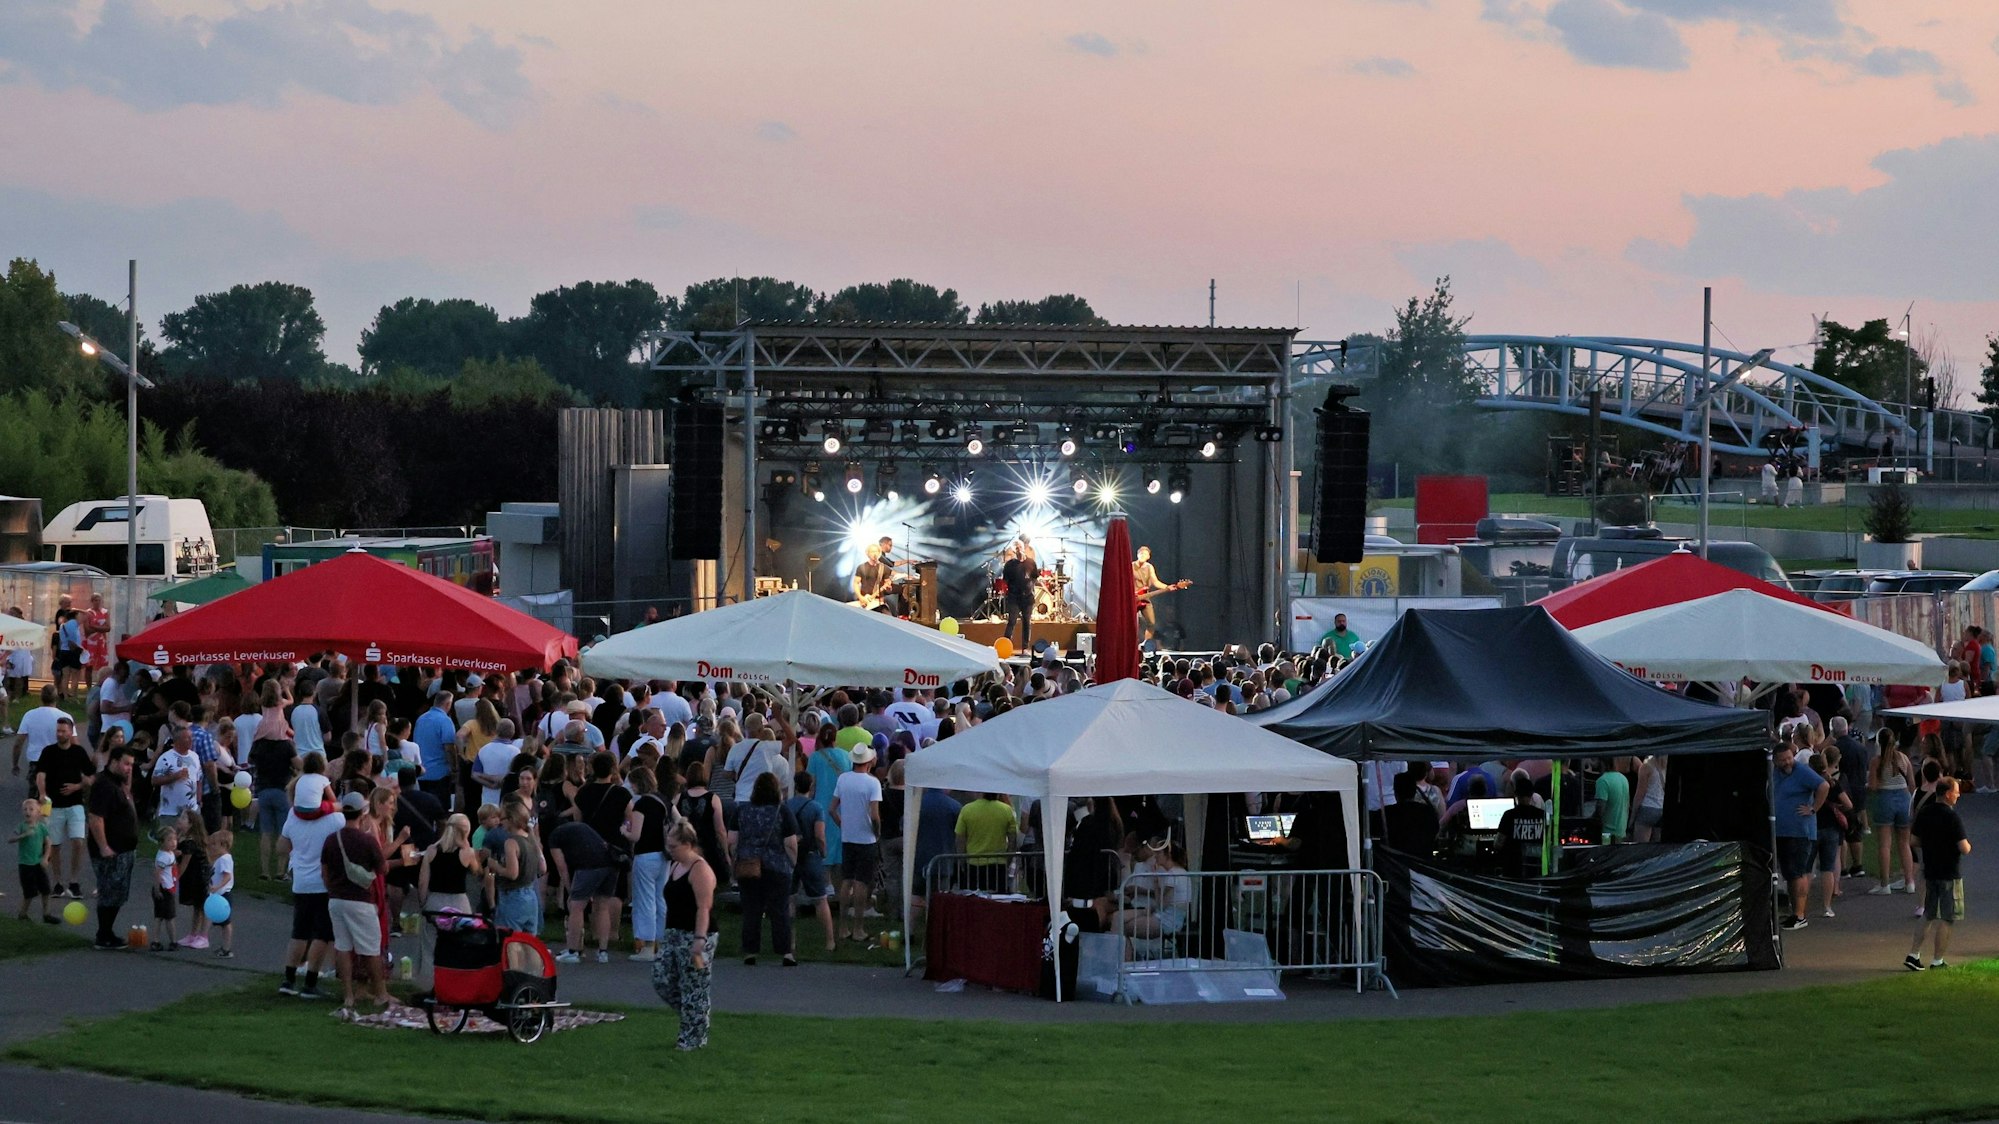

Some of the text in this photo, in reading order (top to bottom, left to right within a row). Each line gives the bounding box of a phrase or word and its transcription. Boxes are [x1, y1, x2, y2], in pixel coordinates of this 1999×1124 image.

[174, 651, 231, 664] Sparkasse
[233, 650, 296, 661] Leverkusen
[386, 652, 443, 665] Sparkasse
[445, 656, 507, 671] Leverkusen
[696, 660, 770, 681] Dom KÖLSCH
[903, 667, 940, 686] Dom
[1613, 661, 1647, 678] om
[1810, 663, 1882, 683] Dom KÖLSCH
[1513, 824, 1543, 840] KREW
